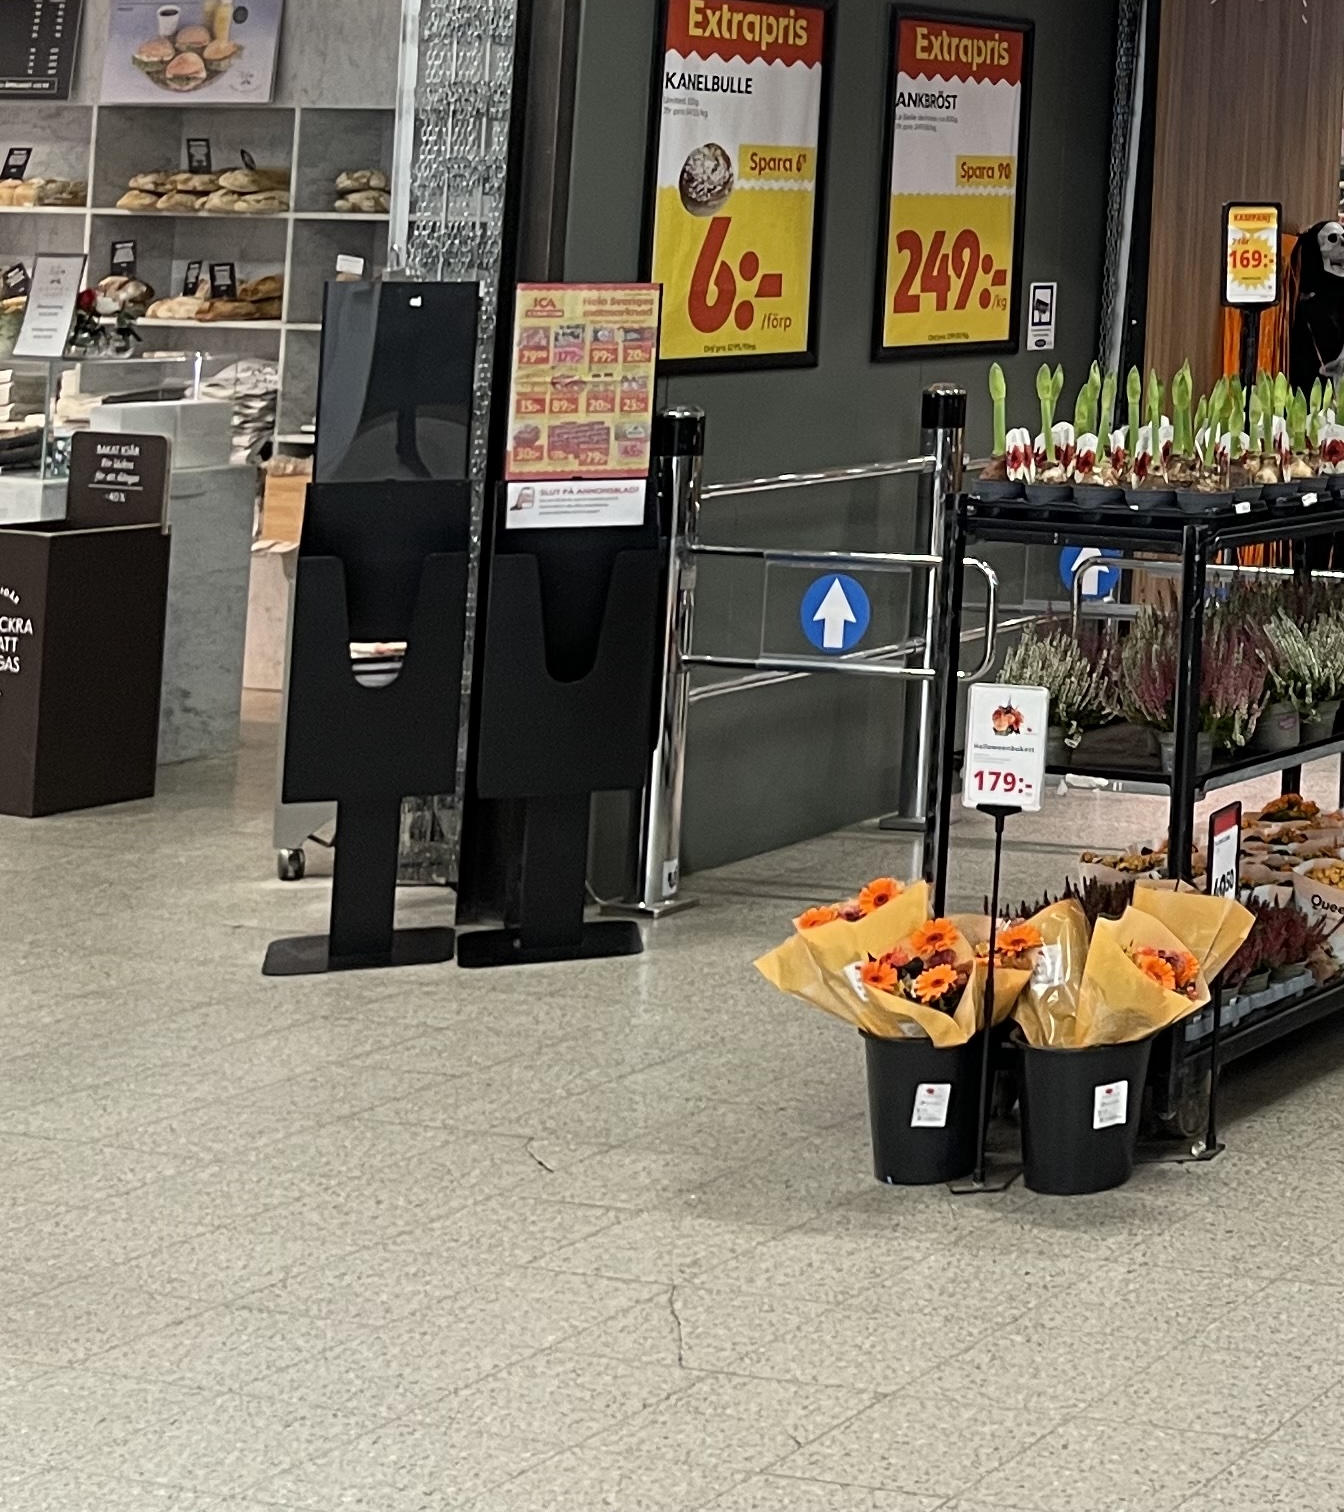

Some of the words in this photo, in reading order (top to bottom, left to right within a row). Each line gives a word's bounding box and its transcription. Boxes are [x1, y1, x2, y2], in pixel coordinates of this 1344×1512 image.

[688, 0, 808, 51] Extrapris
[915, 26, 1009, 70] Extrapris
[665, 72, 752, 94] KANELBULLE
[895, 90, 957, 110] ANKBRÖST
[749, 152, 793, 176] Spara
[961, 162, 994, 183] Spara
[1229, 249, 1274, 269] 169:-
[688, 216, 783, 334] 6:-
[893, 228, 1007, 314] 249:-
[534, 297, 556, 309] ICA
[991, 296, 1007, 311] /kg
[761, 313, 792, 333] /förp
[974, 770, 1033, 794] 179:-
